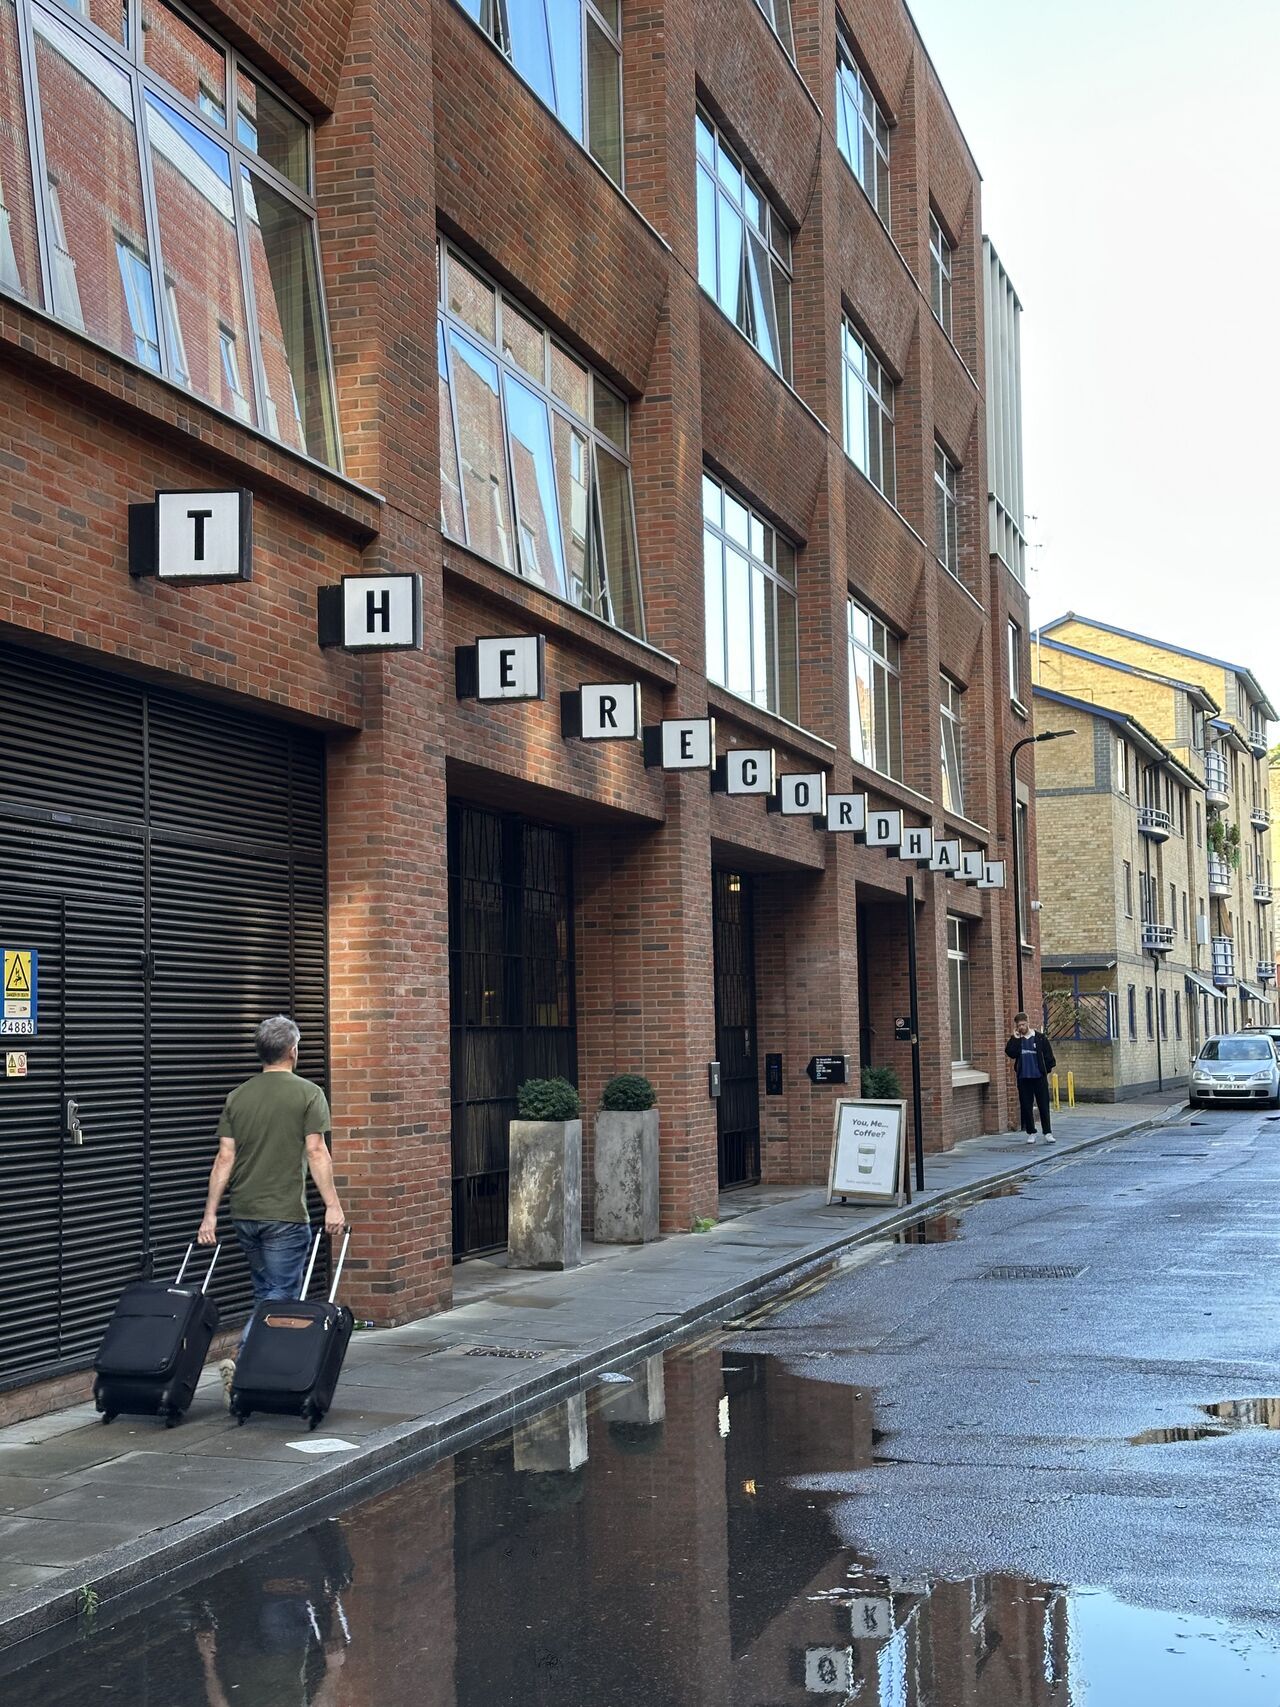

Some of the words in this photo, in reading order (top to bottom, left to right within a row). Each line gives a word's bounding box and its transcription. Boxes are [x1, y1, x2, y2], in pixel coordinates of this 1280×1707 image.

[1, 1021, 33, 1034] 24883
[852, 1118, 869, 1127] You,
[853, 1129, 886, 1138] Coffee?
